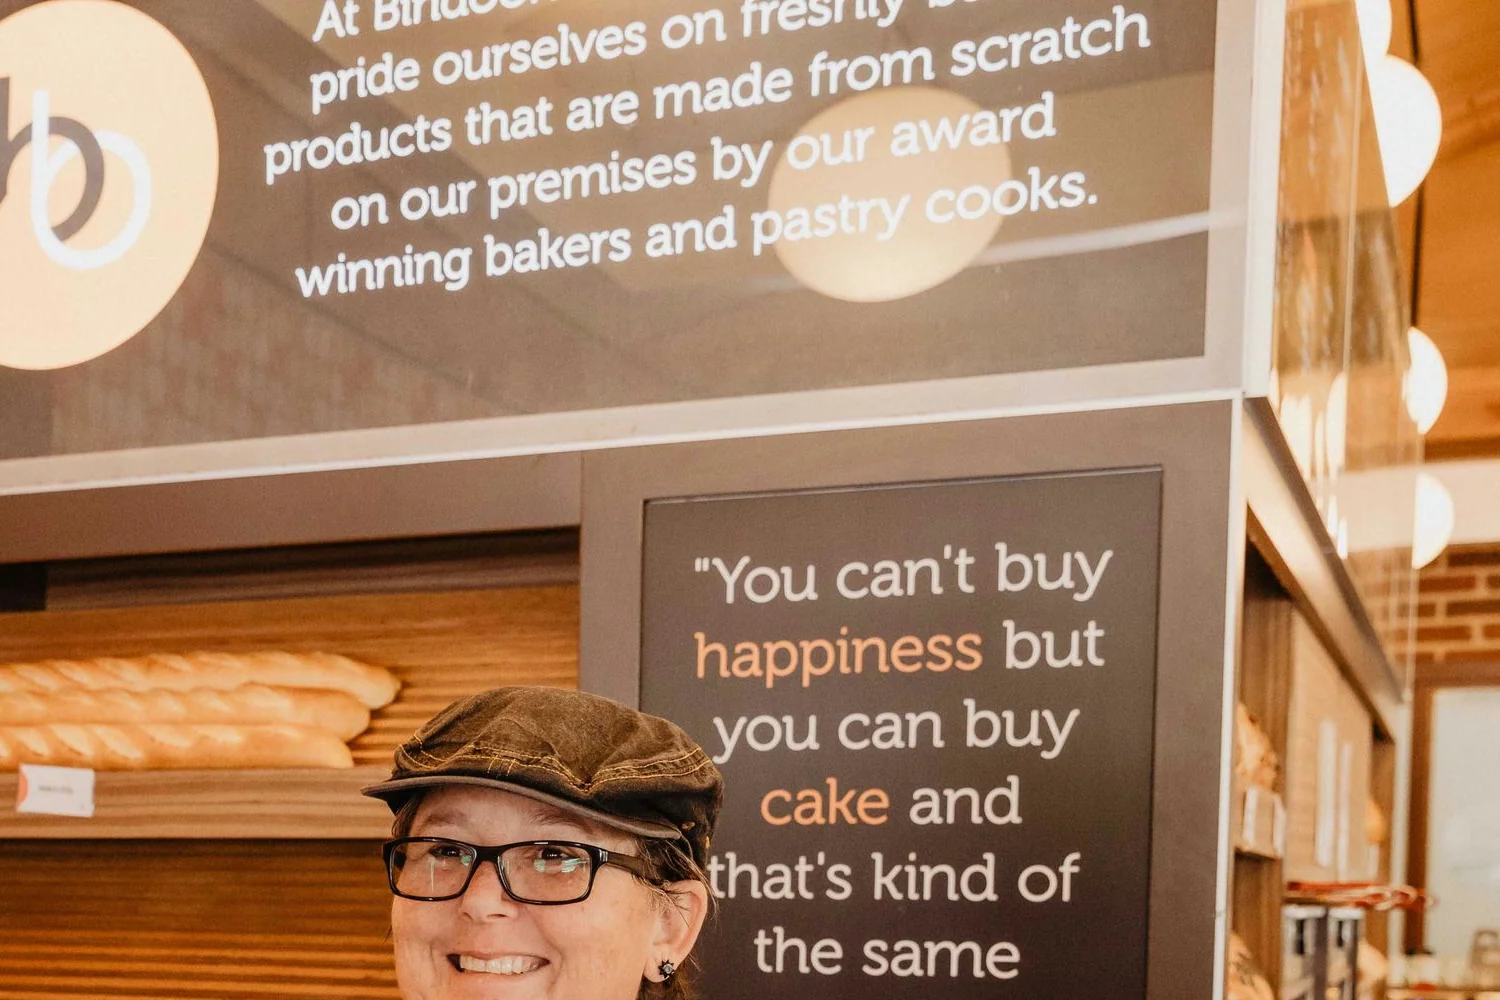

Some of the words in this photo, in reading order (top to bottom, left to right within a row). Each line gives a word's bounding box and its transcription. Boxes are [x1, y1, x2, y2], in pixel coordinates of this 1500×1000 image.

[312, 0, 360, 42] At
[374, 0, 540, 32] Bindo
[310, 52, 421, 114] pride
[433, 22, 648, 85] ourselves
[661, 8, 727, 49] on
[264, 115, 453, 185] products
[465, 96, 554, 146] that
[566, 90, 640, 132] are
[653, 61, 794, 119] made
[808, 44, 935, 97] from
[950, 5, 1151, 78] scratch
[331, 192, 389, 230] on
[401, 178, 477, 221] our
[488, 150, 697, 220] premises
[711, 136, 774, 188] by
[786, 125, 875, 171] our
[890, 91, 1057, 158] award
[295, 244, 473, 298] winning
[483, 227, 632, 278] bakers
[645, 205, 738, 258] and
[750, 193, 912, 256] pastry
[925, 166, 1098, 225] cooks.
[694, 555, 819, 605] "You
[835, 544, 976, 599] can't
[994, 542, 1114, 602] buy
[693, 626, 984, 689] happiness
[1002, 619, 1106, 670] but
[712, 712, 820, 765] you
[837, 707, 945, 752] can
[963, 698, 1081, 761] buy
[760, 776, 891, 827] cake
[909, 774, 1024, 826] and
[706, 850, 854, 902] that's
[870, 851, 999, 902] kind
[1017, 851, 1081, 903] of
[753, 926, 844, 976] the
[862, 937, 1022, 981] same
